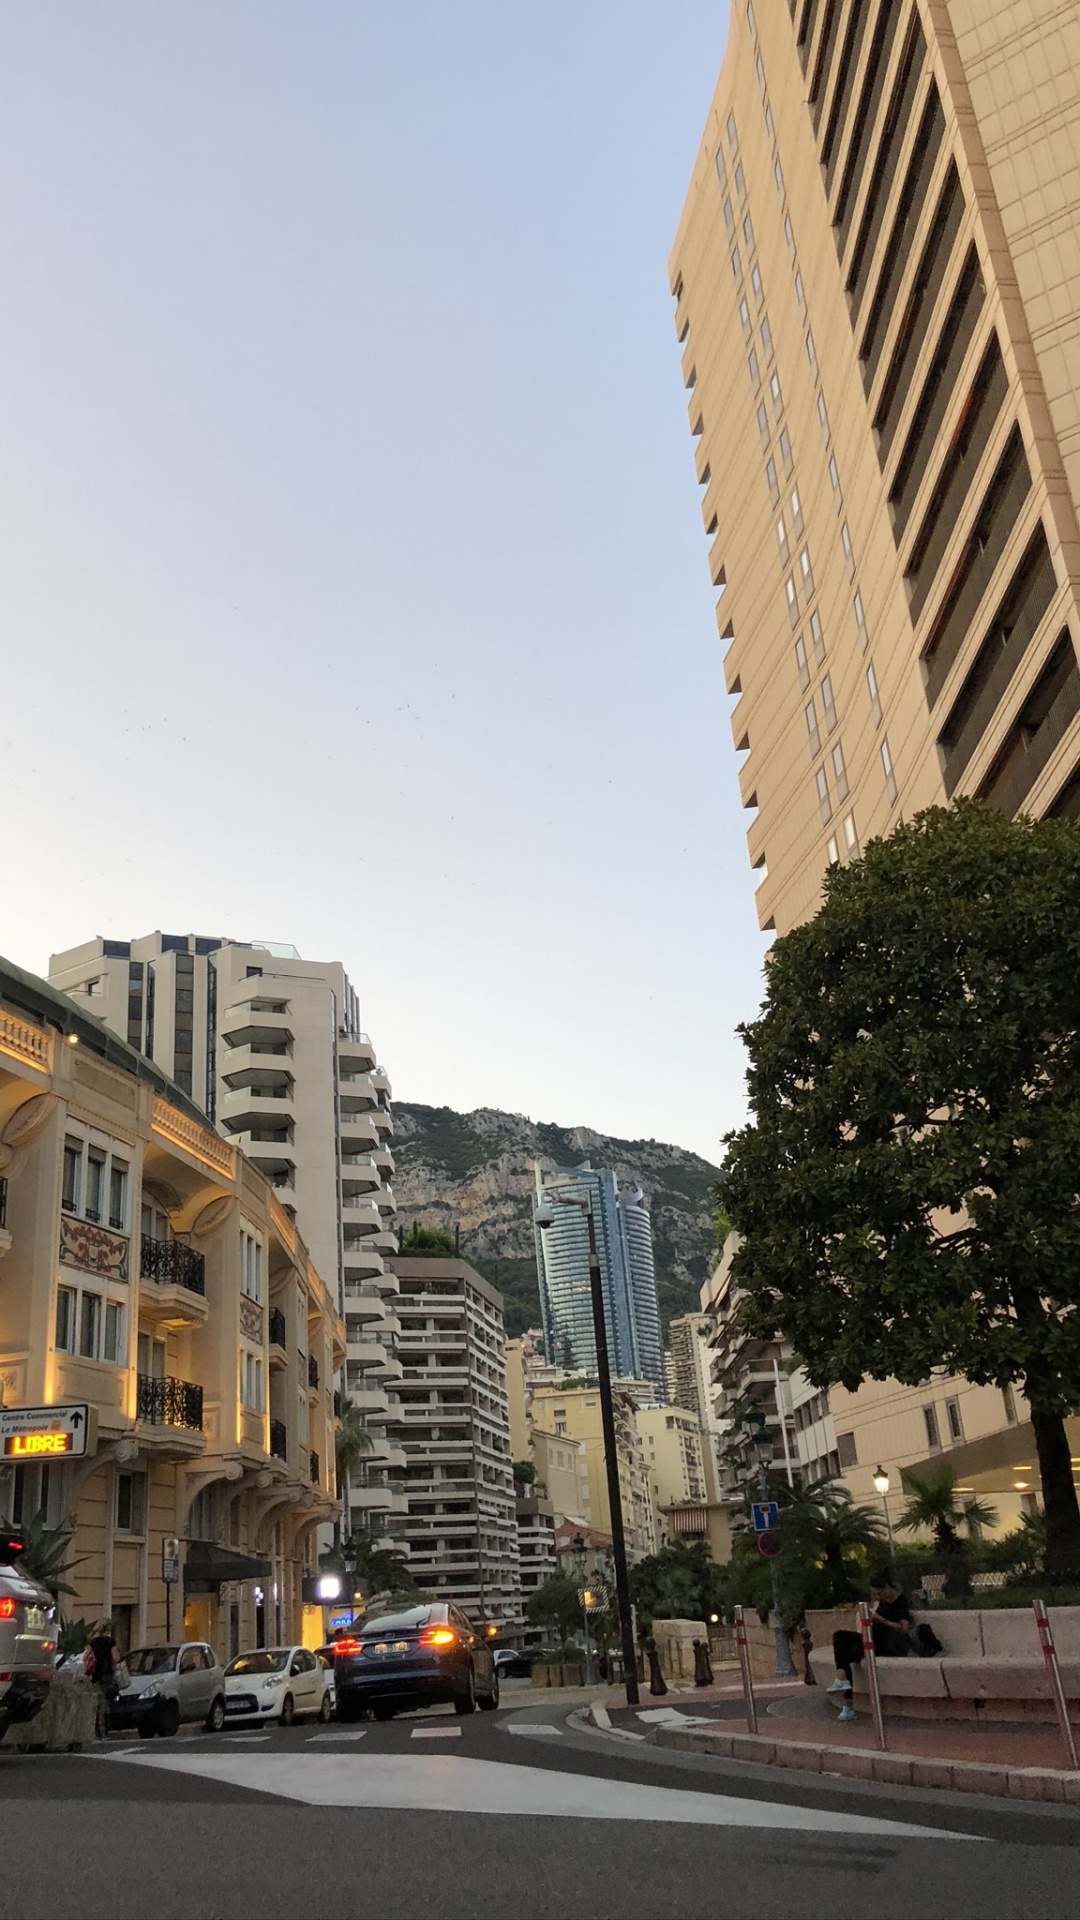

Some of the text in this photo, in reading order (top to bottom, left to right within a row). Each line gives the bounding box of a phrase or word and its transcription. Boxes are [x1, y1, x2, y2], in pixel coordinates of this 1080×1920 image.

[2, 1410, 68, 1421] Centre Commercial
[13, 1433, 67, 1454] LIBRE
